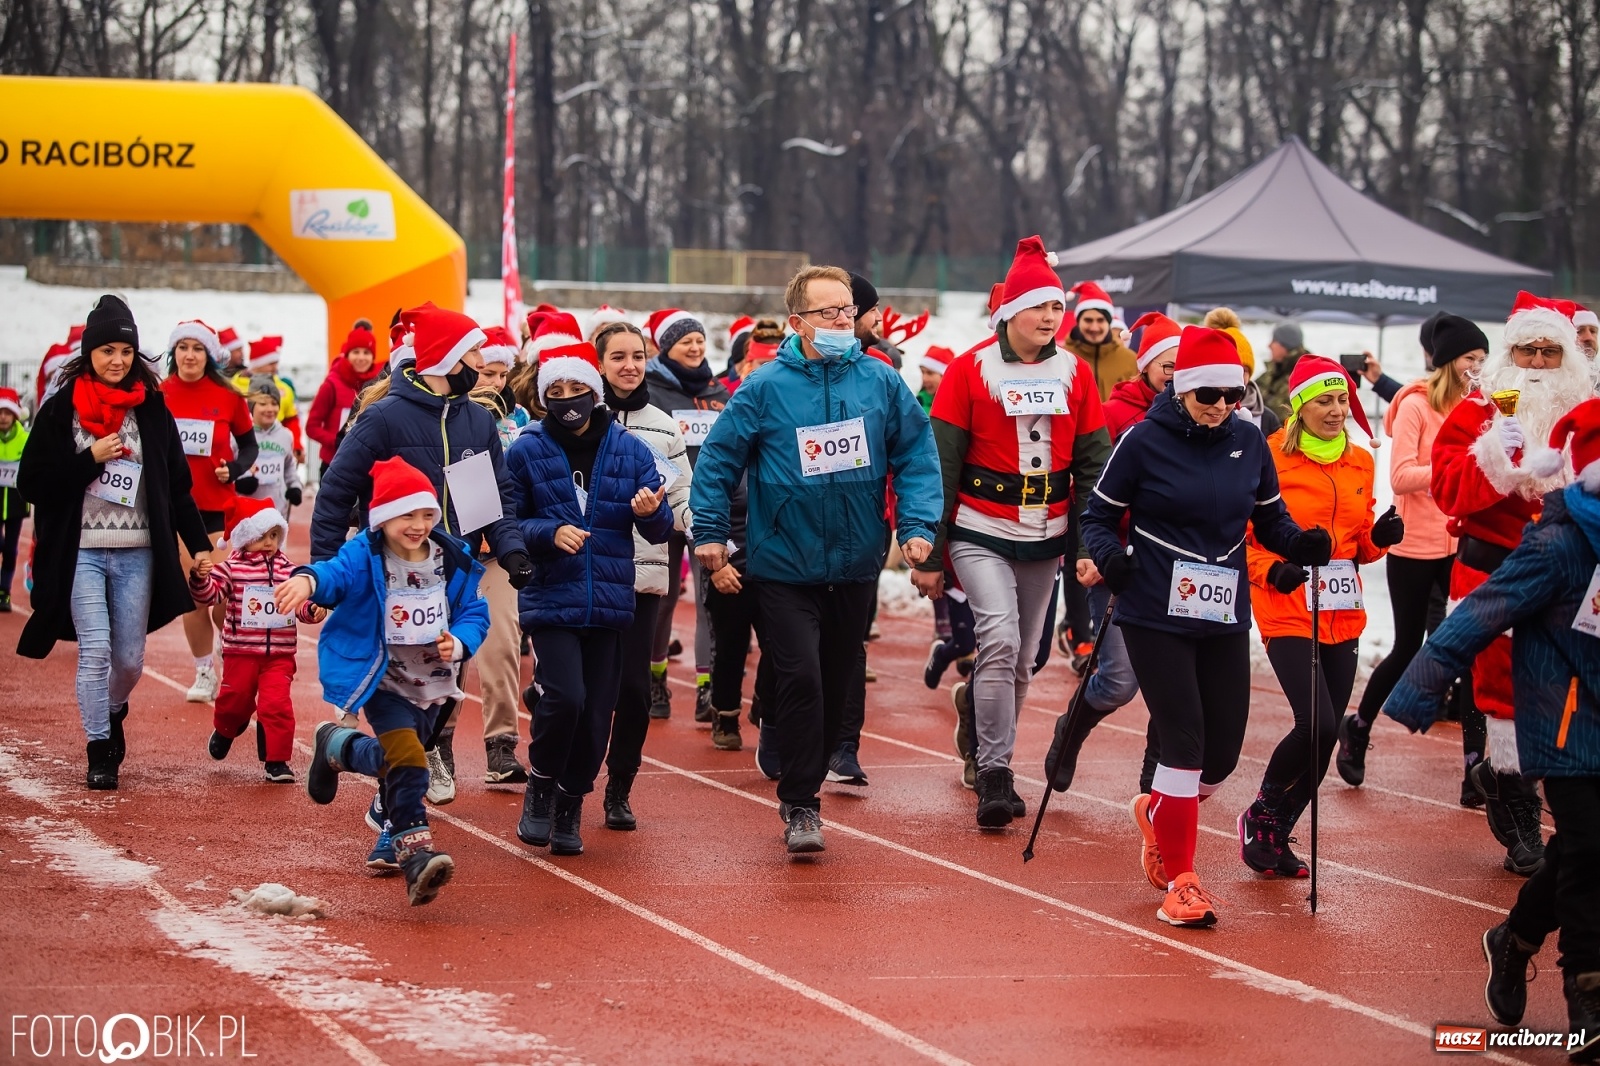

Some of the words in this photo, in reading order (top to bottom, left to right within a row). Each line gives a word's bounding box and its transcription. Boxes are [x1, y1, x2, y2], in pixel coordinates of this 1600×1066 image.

[20, 136, 196, 168] RACIBÓRZ
[1291, 279, 1437, 305] www.raciborz.pl
[1024, 391, 1055, 403] 157
[180, 430, 207, 444] 049
[691, 422, 715, 434] 03
[824, 434, 861, 457] 097
[0, 467, 16, 479] 77
[261, 463, 281, 475] 024
[99, 470, 133, 491] 089
[1199, 583, 1232, 606] 050
[1328, 577, 1357, 595] 051
[412, 602, 443, 627] 054
